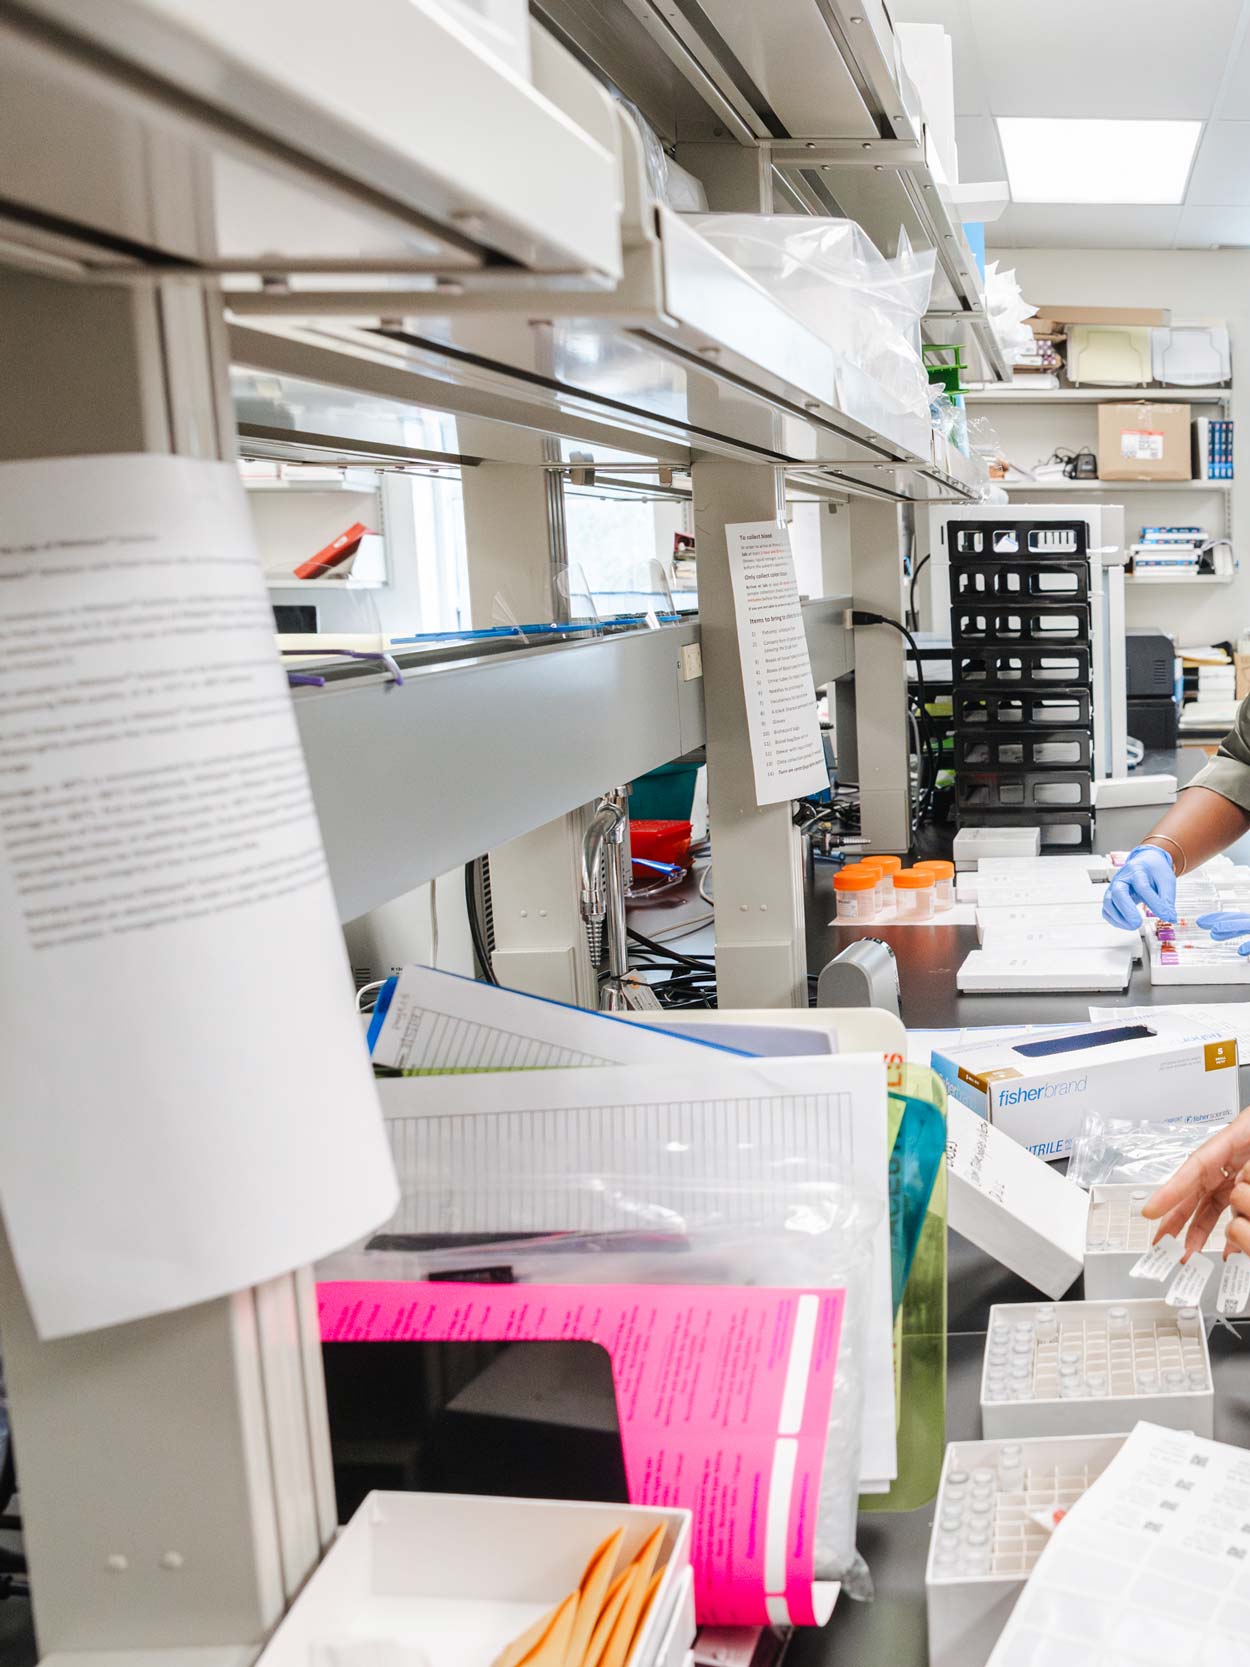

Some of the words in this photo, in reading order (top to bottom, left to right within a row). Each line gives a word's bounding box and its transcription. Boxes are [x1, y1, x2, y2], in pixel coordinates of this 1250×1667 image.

[749, 617, 764, 625] Items
[999, 1074, 1088, 1107] fisherbrand
[1026, 1139, 1064, 1156] ITRILE
